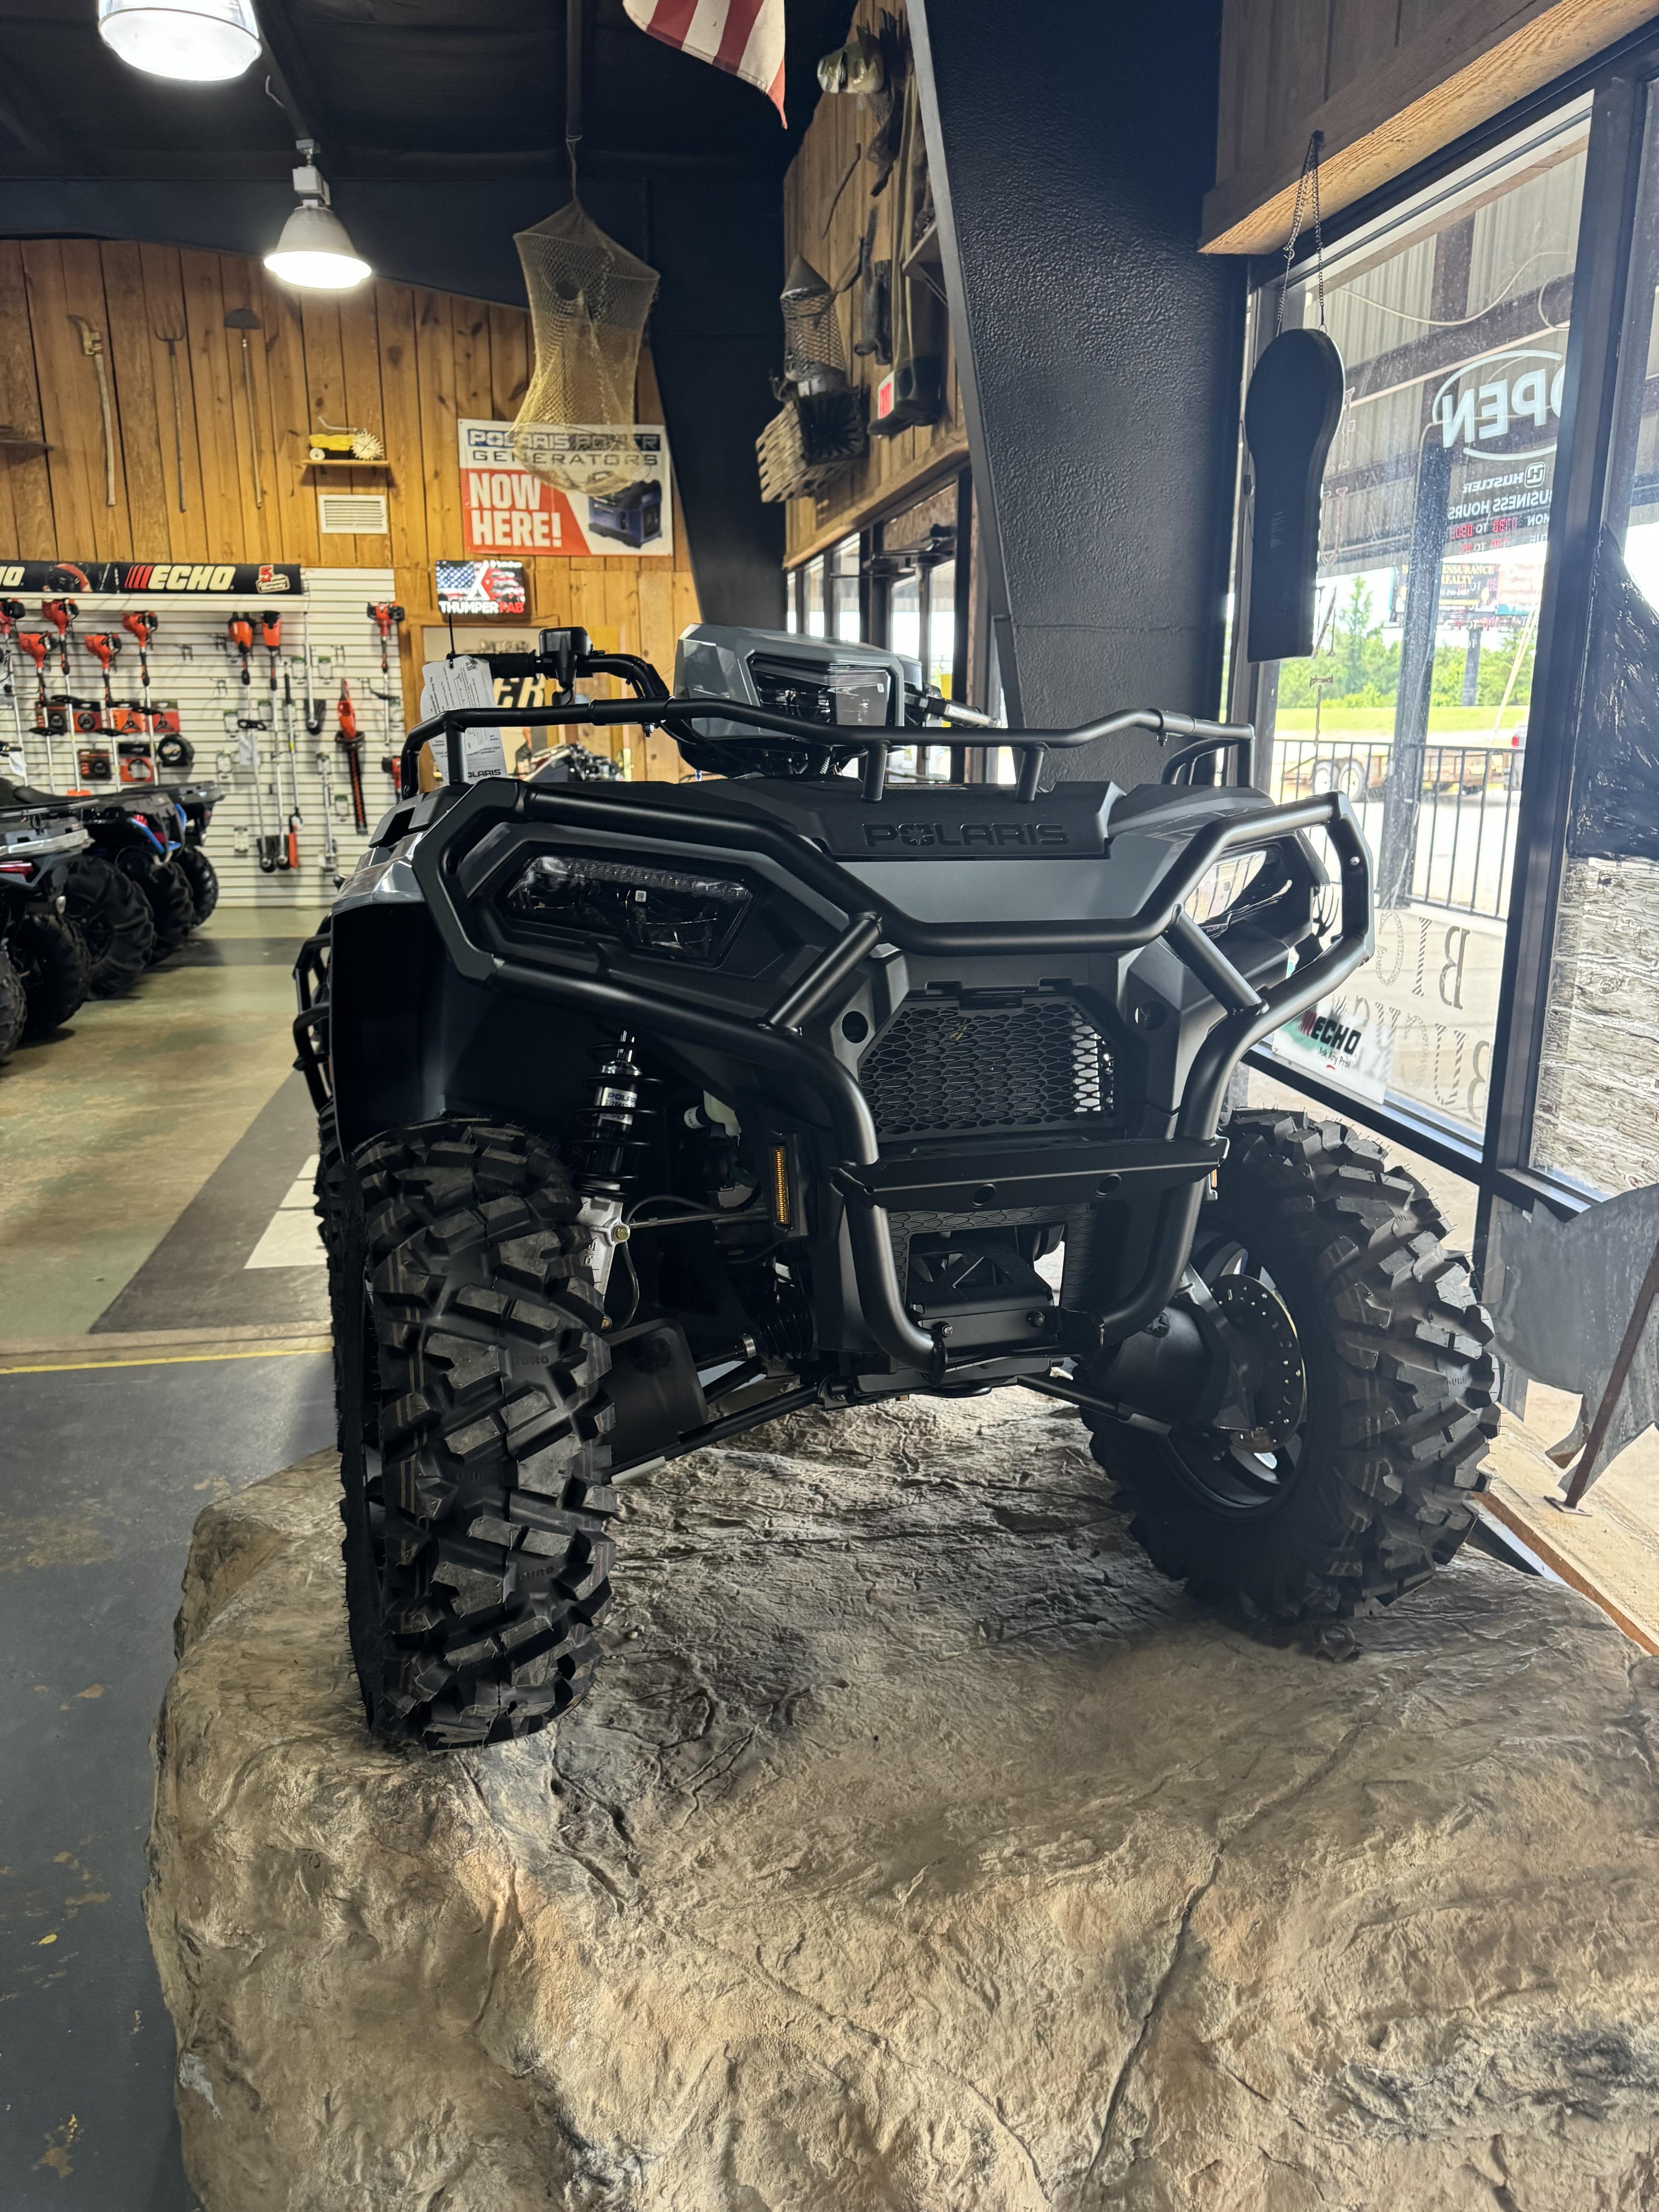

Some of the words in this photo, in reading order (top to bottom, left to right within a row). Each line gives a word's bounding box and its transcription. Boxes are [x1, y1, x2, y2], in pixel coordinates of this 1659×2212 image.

[469, 429, 571, 450] POLARIS
[575, 434, 659, 450] POWER
[473, 450, 657, 465] GENERATORS
[469, 472, 541, 510] NOW
[471, 510, 562, 548] HERE!
[148, 565, 236, 591] ECHO
[261, 566, 272, 582] 5
[468, 769, 501, 778] OLARIS
[862, 823, 1069, 846] POLARIS
[1310, 1016, 1362, 1055] ECHO
[1318, 1047, 1327, 1058] Ask
[1328, 1051, 1338, 1065] Any
[1338, 1056, 1351, 1069] Pro!
